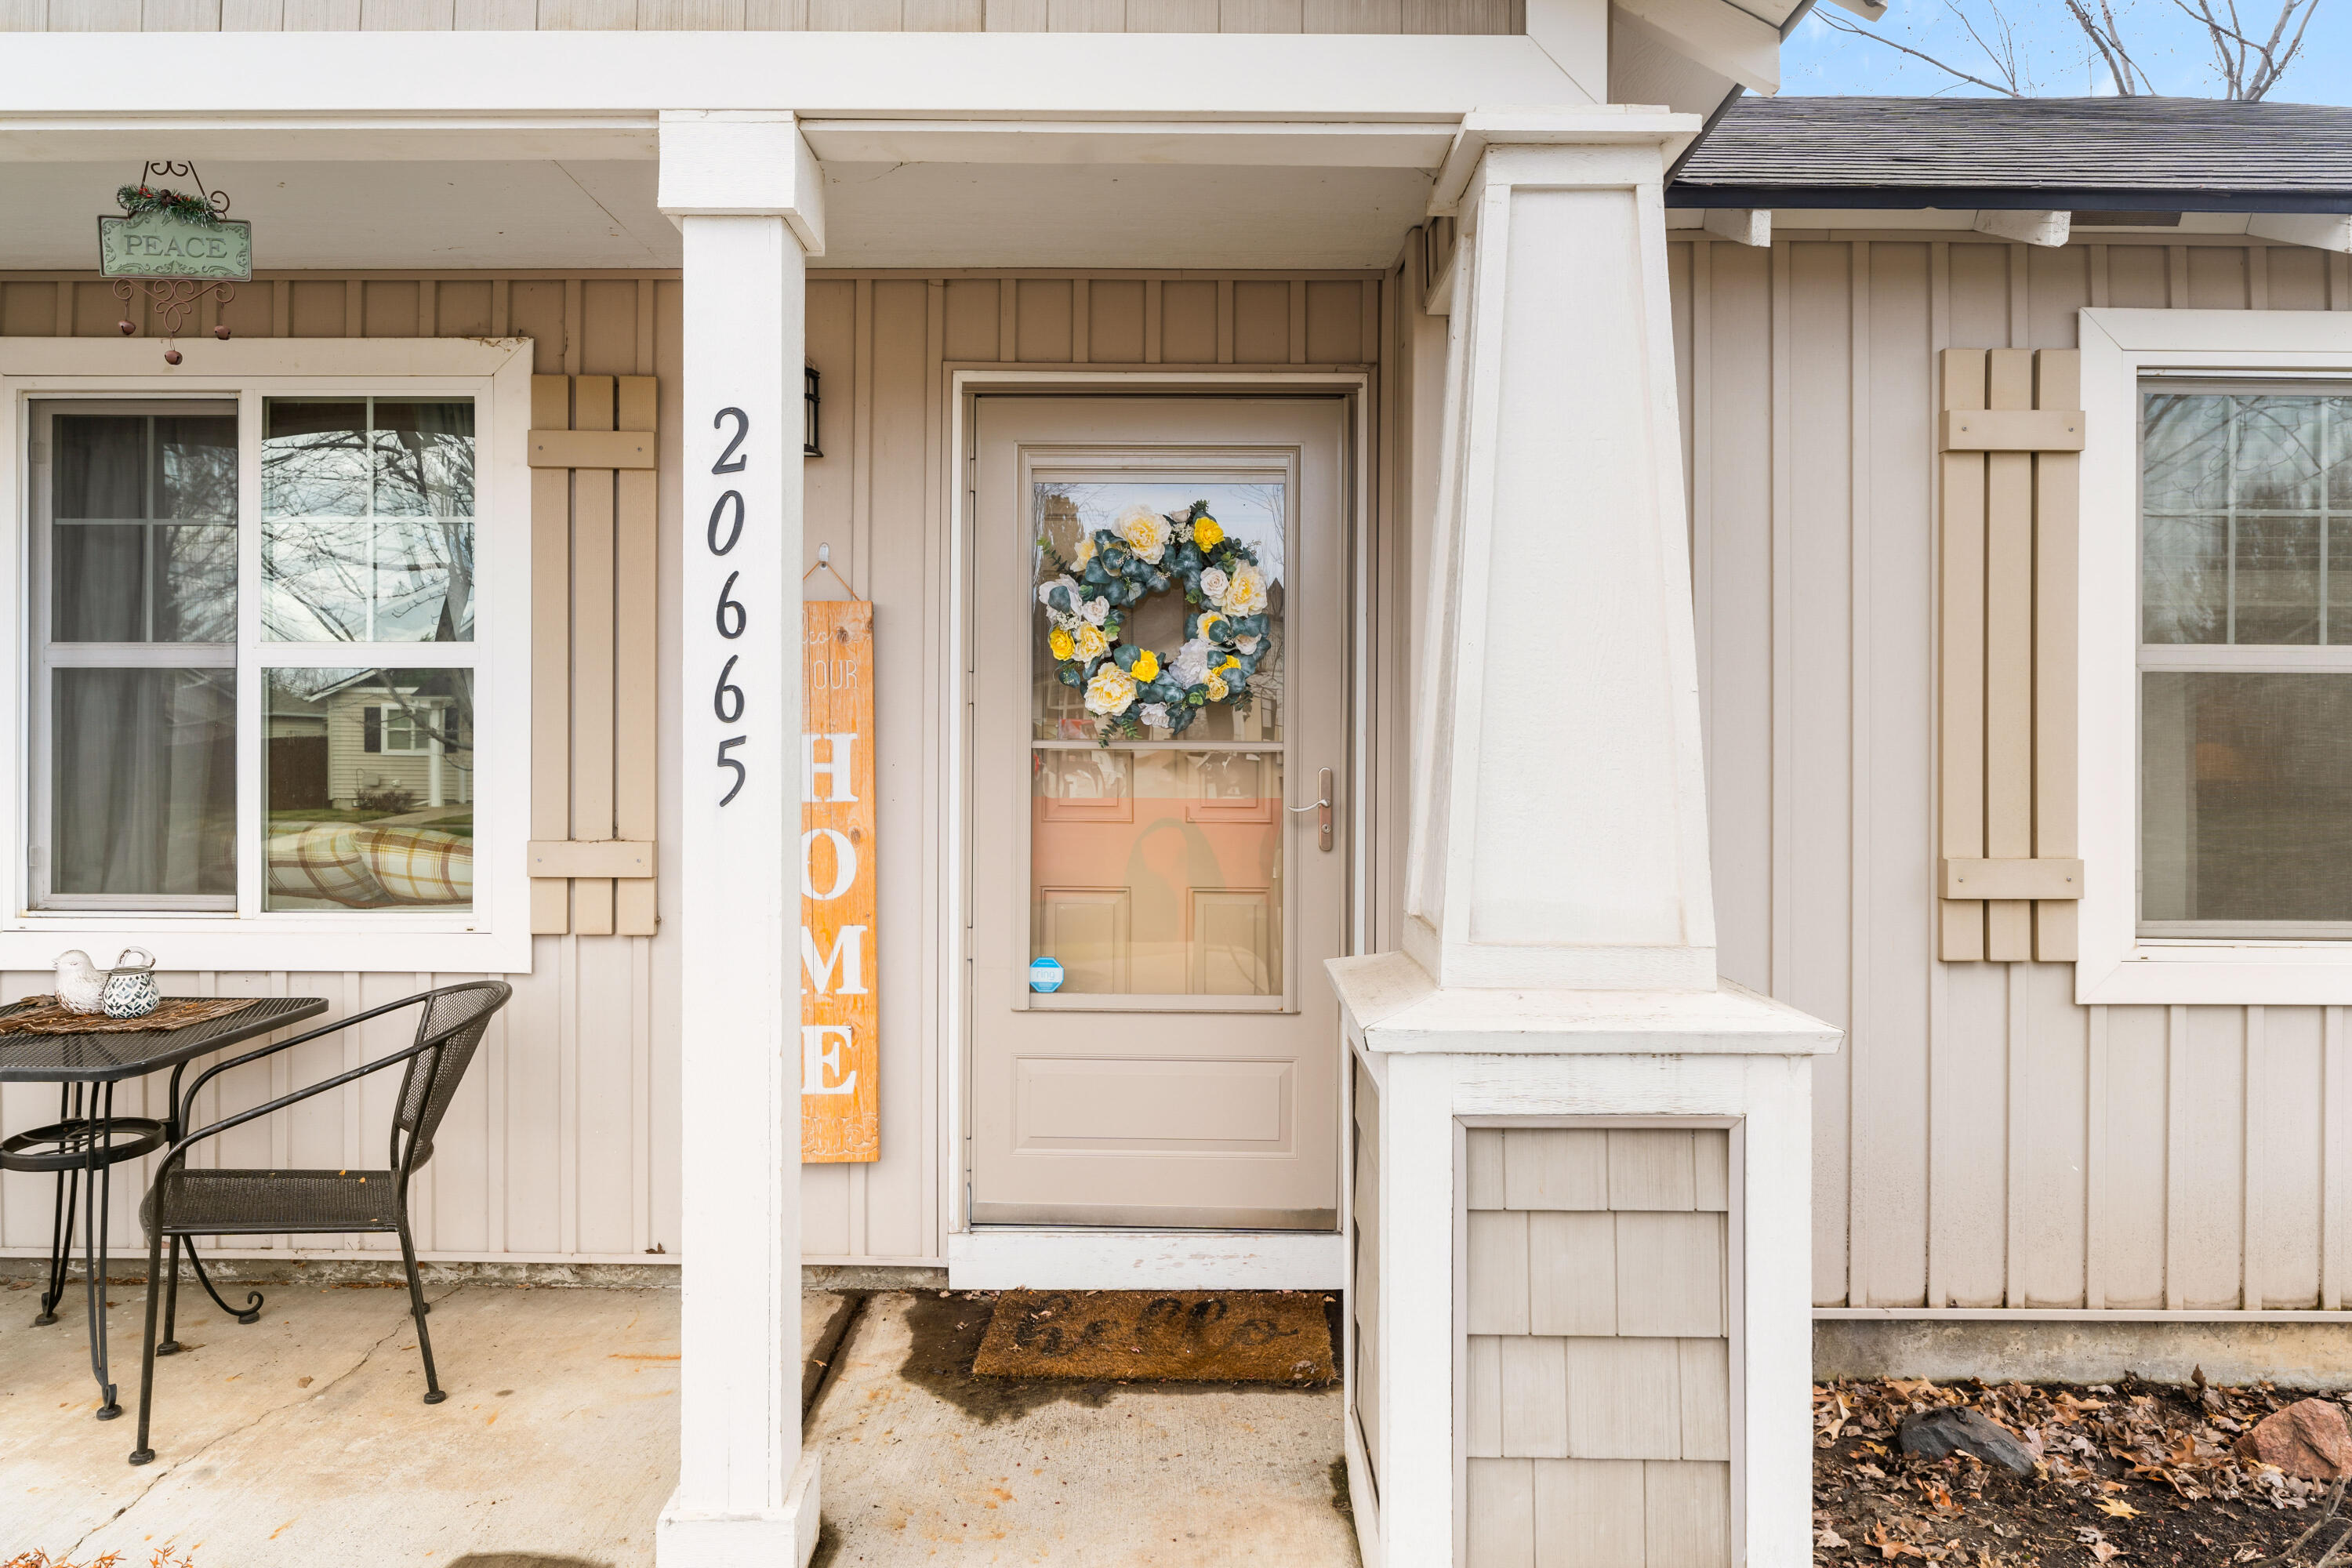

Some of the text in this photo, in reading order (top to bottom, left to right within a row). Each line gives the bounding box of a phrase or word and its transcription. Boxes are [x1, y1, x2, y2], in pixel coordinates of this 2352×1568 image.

[125, 234, 227, 258] PEACE
[707, 407, 750, 808] 20665
[813, 659, 858, 690] OUR
[801, 732, 869, 1094] HOME
